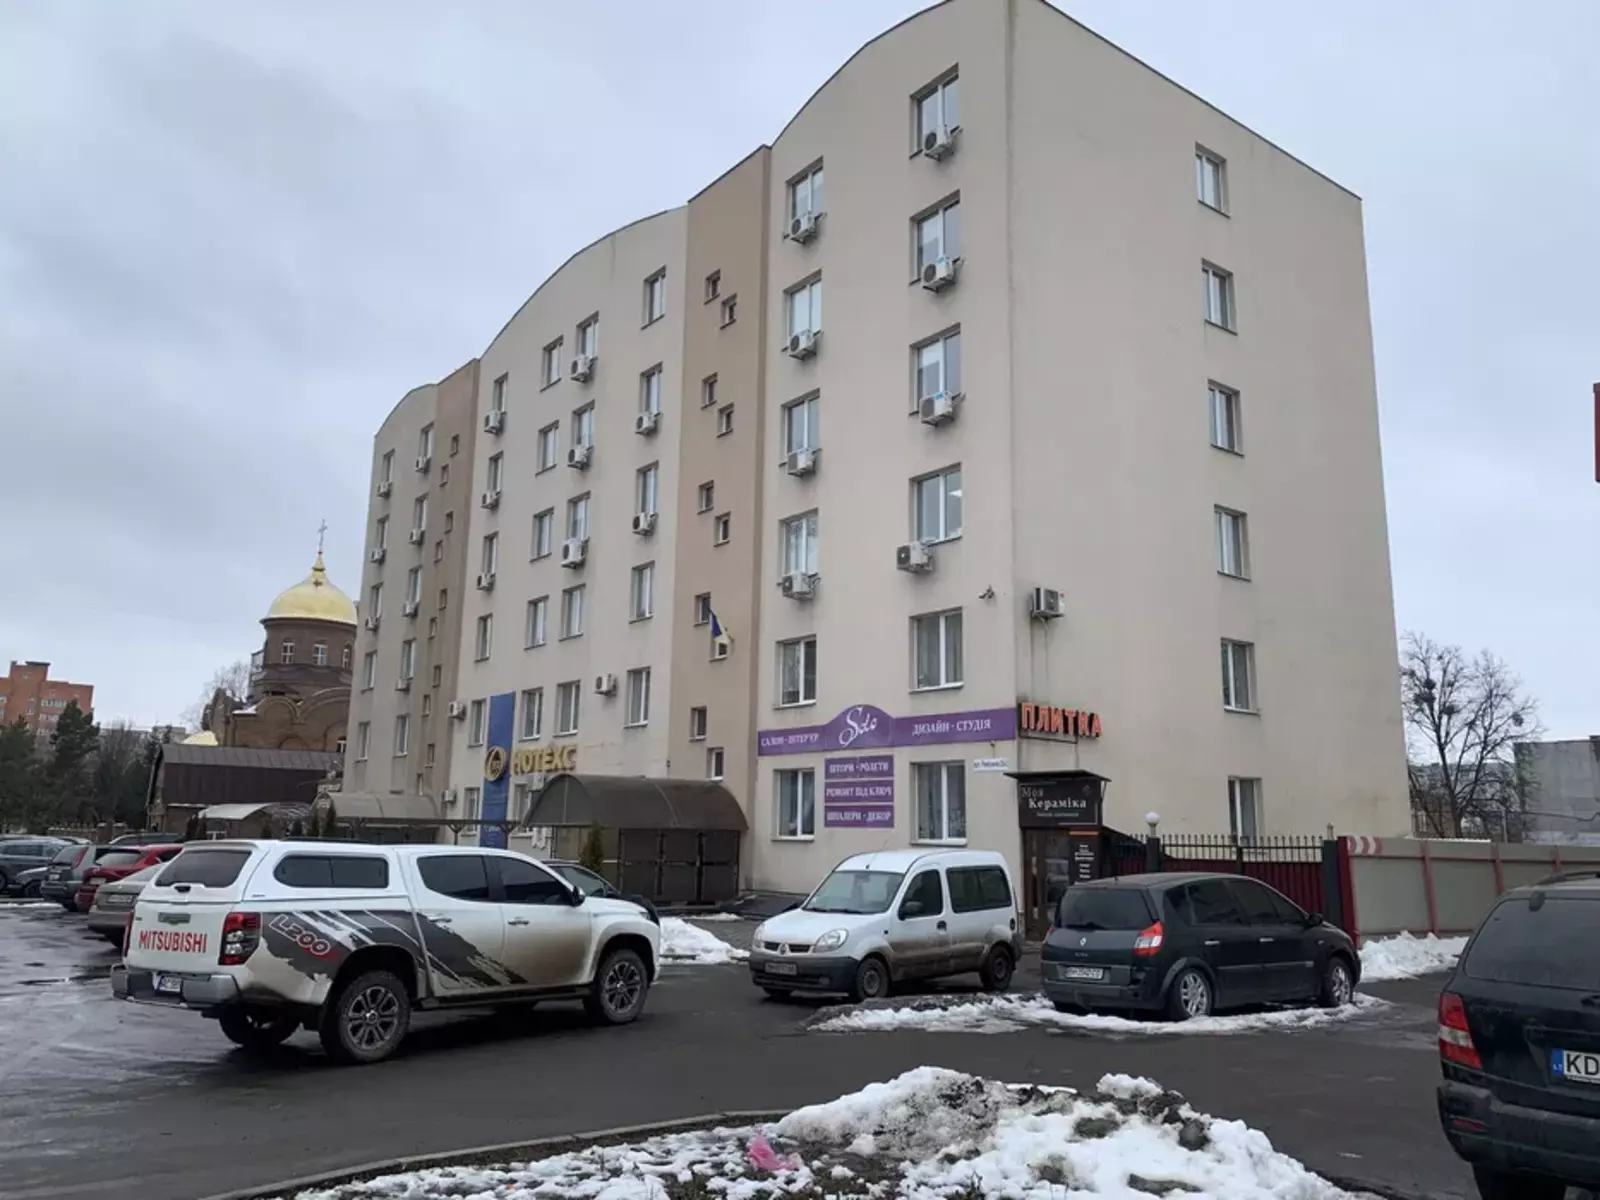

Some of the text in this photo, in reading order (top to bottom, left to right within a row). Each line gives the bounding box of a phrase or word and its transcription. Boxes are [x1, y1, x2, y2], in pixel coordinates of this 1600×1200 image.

[911, 718, 992, 737] ДИЗАЙН СТУДІЯ
[1021, 702, 1103, 736] ПЛИТКА
[138, 929, 207, 953] MITSUBISHI
[268, 913, 331, 956] L200
[1566, 1053, 1599, 1076] KD
